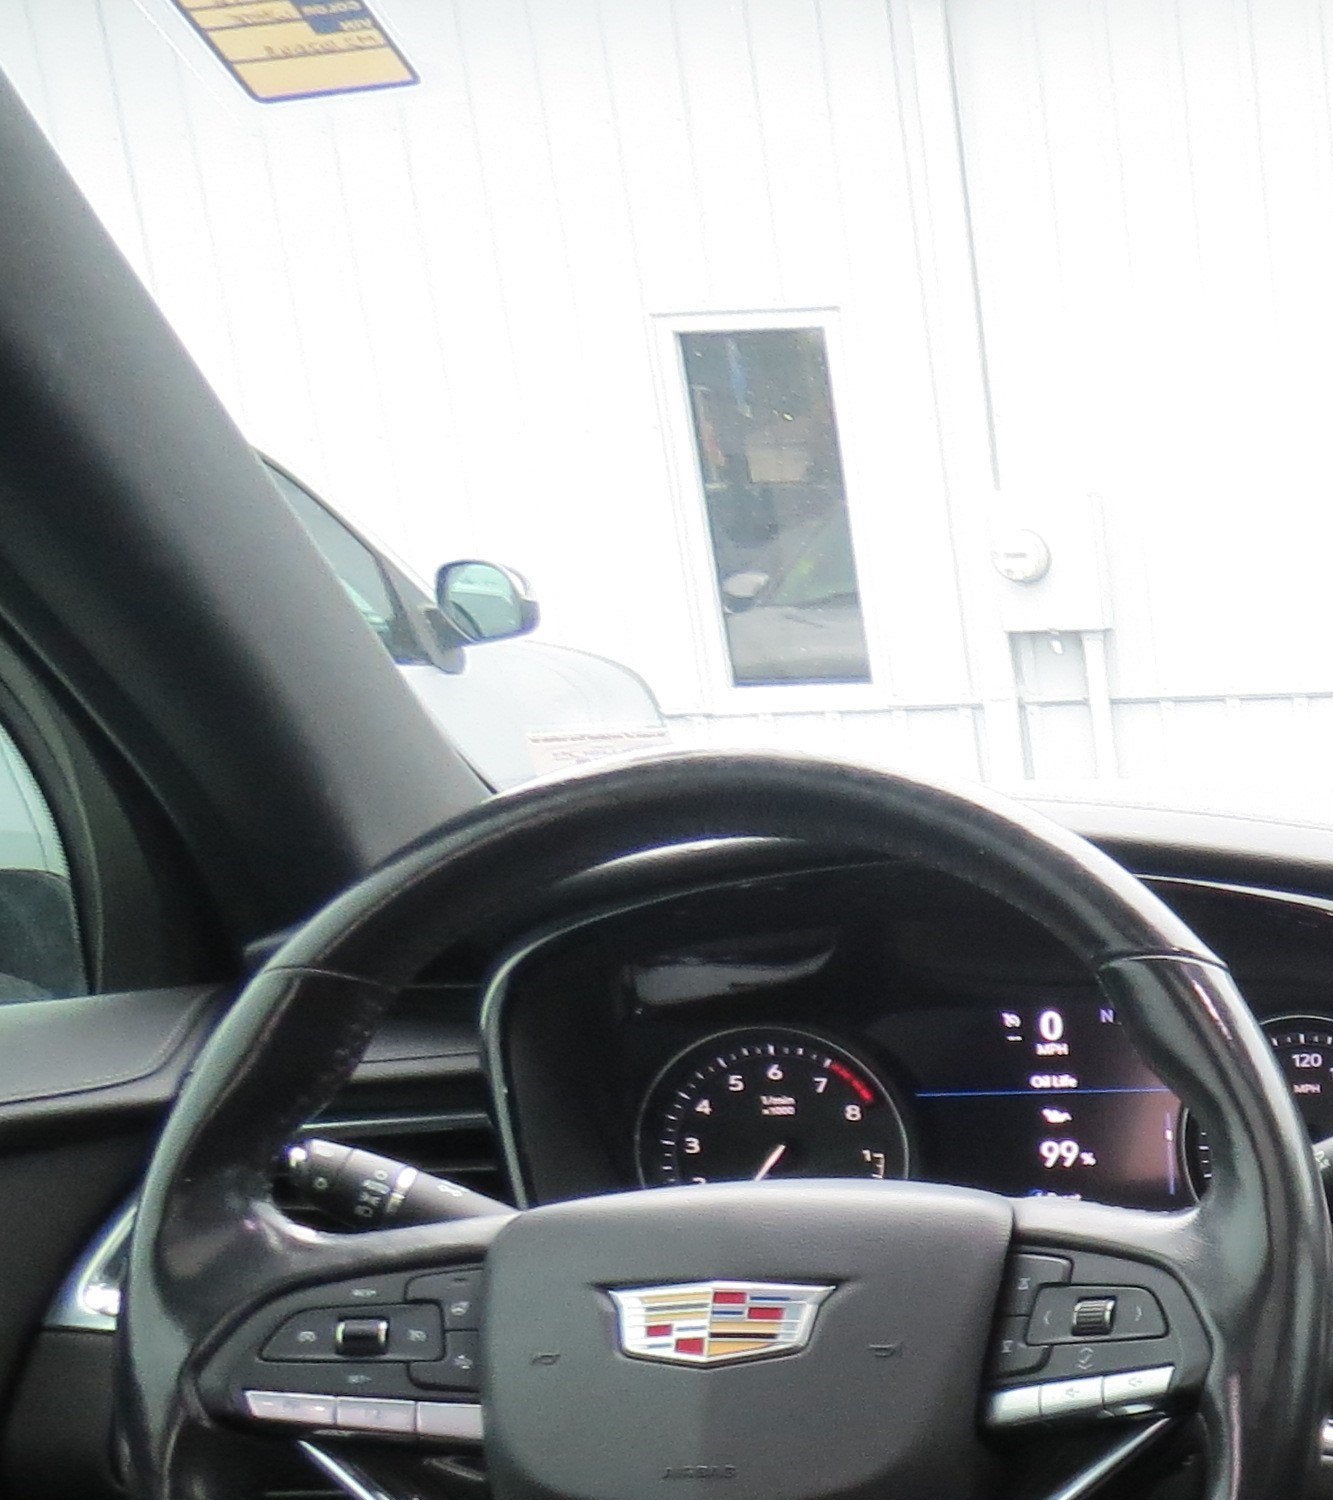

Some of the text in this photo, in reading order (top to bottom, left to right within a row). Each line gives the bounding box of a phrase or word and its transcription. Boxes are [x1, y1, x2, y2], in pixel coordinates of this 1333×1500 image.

[1100, 1009, 1115, 1024] N
[1039, 1010, 1064, 1041] 0
[1036, 1043, 1069, 1056] MPH
[1291, 1053, 1323, 1068] 120
[766, 1063, 784, 1081] 6
[728, 1075, 745, 1092] 5
[813, 1077, 829, 1094] 7
[1030, 1074, 1078, 1089] Oil Life
[1293, 1084, 1322, 1094] MPH
[695, 1099, 713, 1116] 4
[844, 1104, 863, 1121] 8
[684, 1137, 701, 1154] 3
[1039, 1140, 1079, 1169] 99
